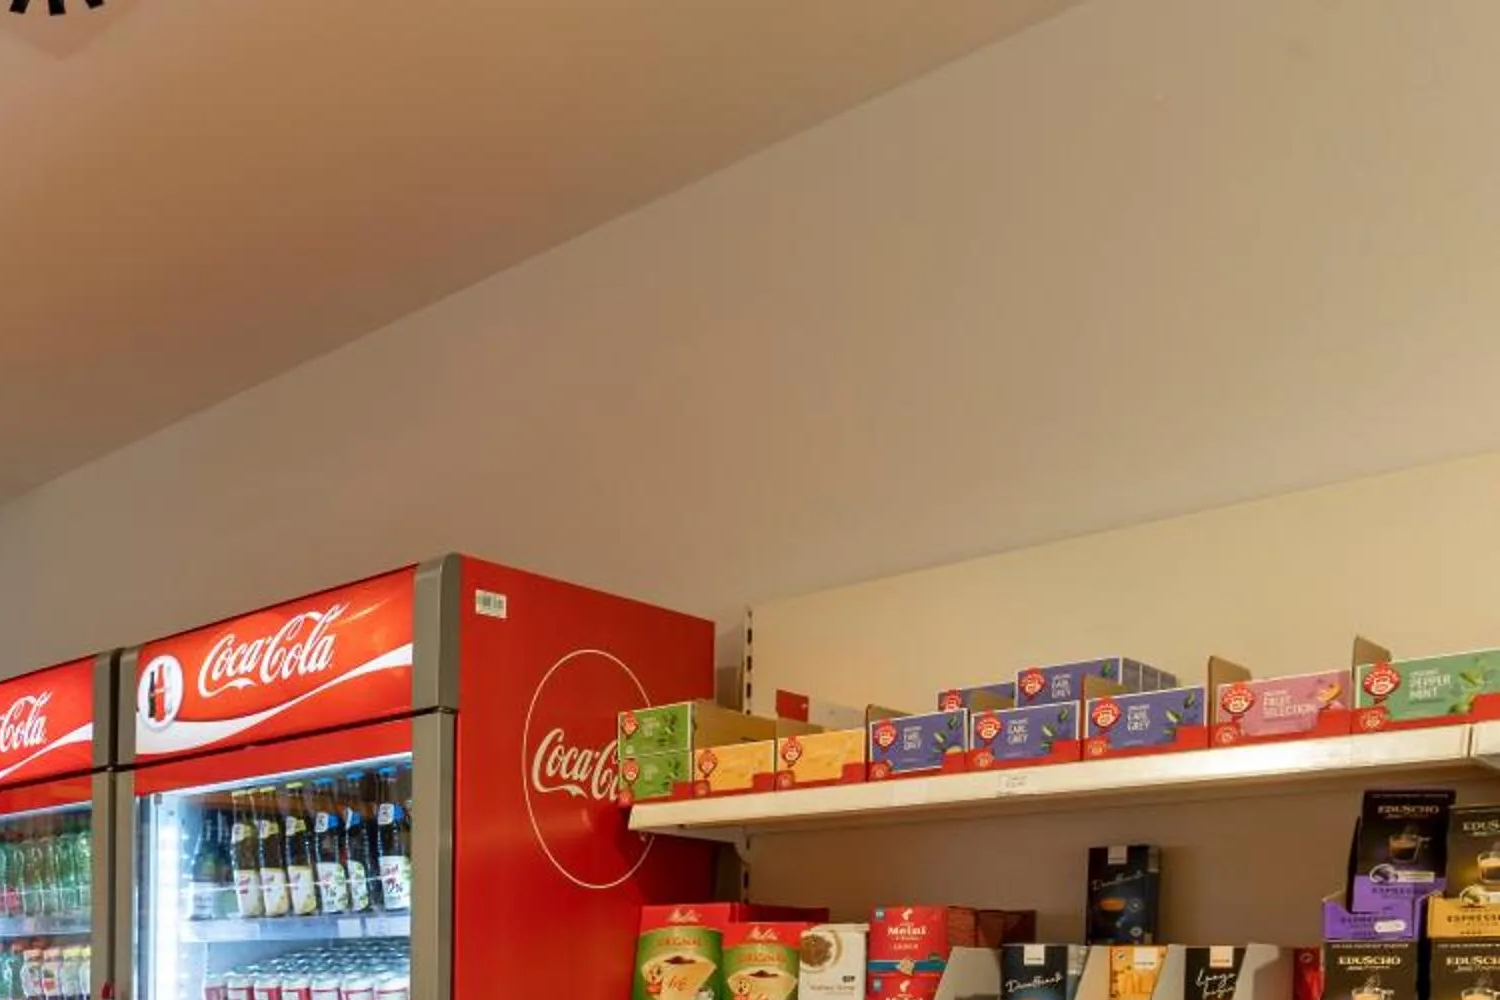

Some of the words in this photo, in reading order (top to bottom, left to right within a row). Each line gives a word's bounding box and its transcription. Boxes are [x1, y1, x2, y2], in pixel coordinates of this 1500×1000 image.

[198, 602, 349, 698] Coca-Cola
[532, 728, 618, 801] Coca-Co
[1338, 955, 1402, 966] EDUSCHO
[1446, 955, 1500, 966] EDUSC
